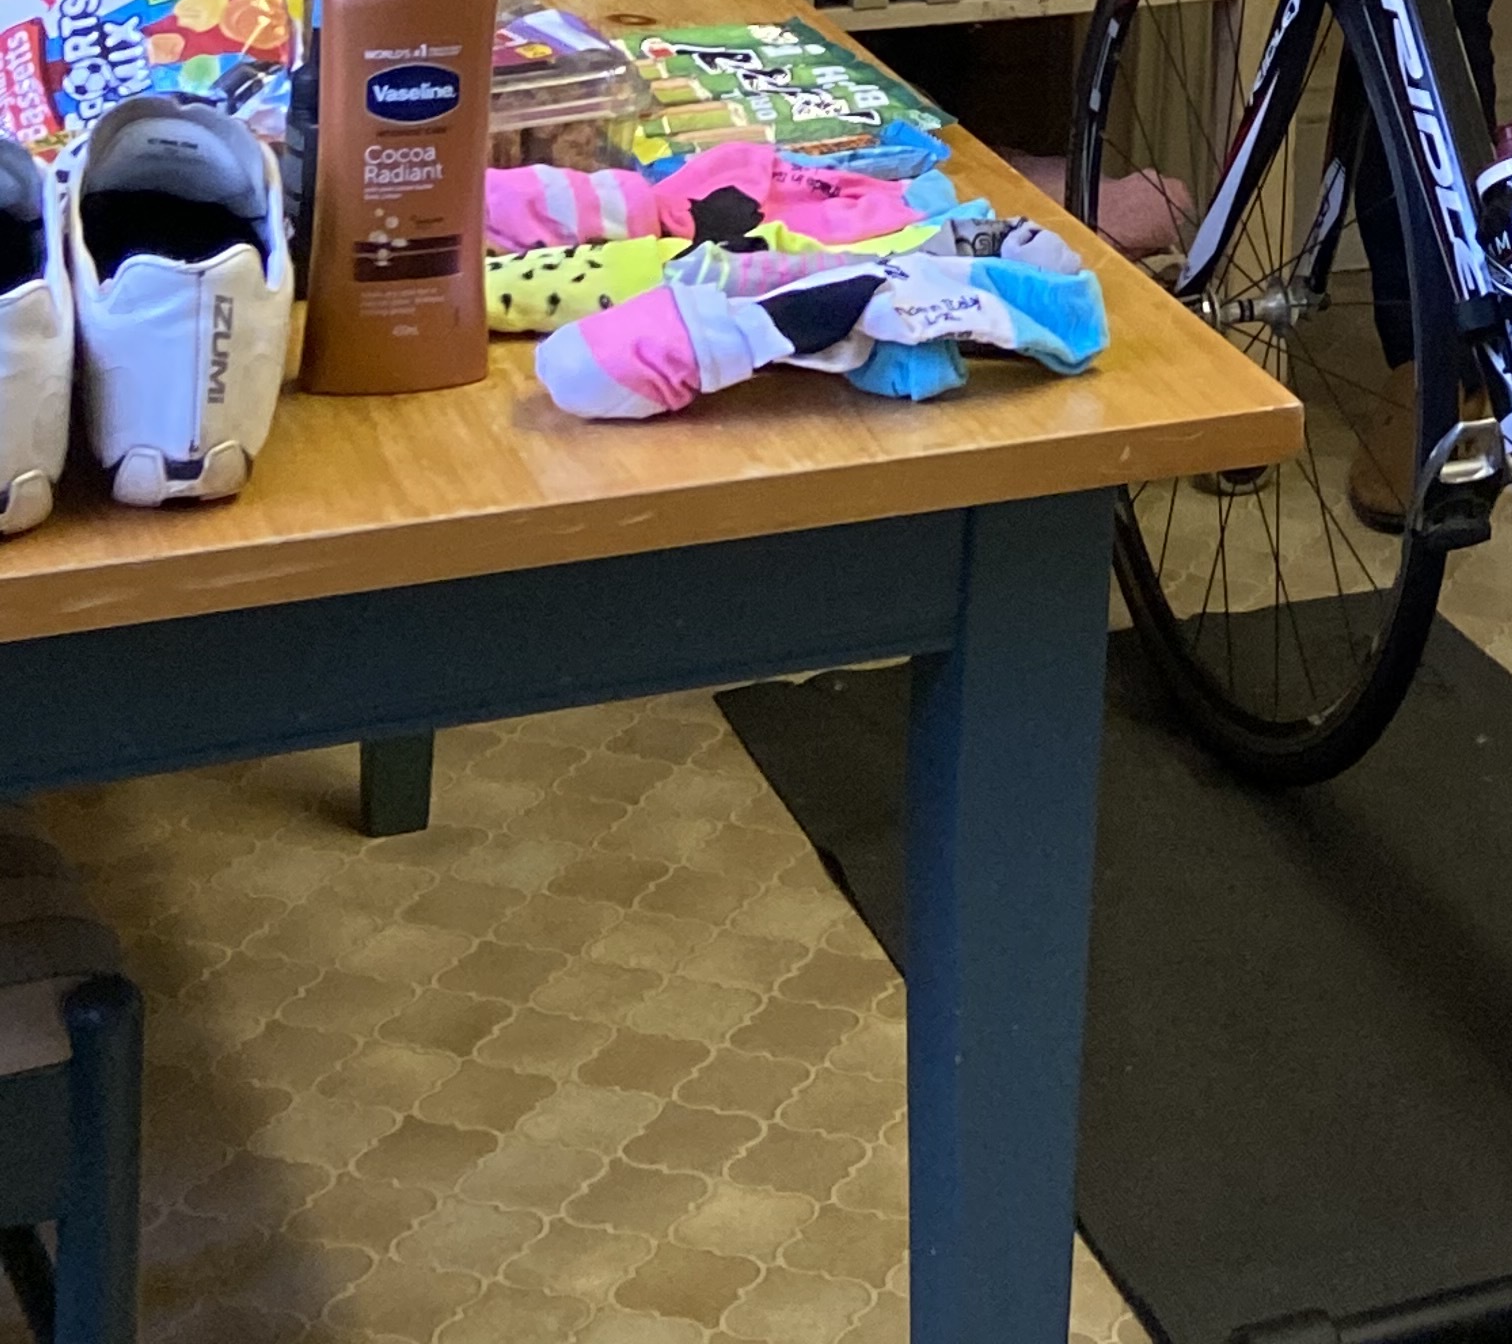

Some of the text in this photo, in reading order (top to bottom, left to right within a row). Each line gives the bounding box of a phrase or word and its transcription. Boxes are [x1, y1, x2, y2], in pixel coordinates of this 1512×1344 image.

[102, 15, 152, 99] MIX
[372, 81, 455, 104] Vaseline
[364, 144, 437, 165] Cocoa
[364, 163, 443, 185] Radiant
[207, 294, 233, 404] IZUMI
